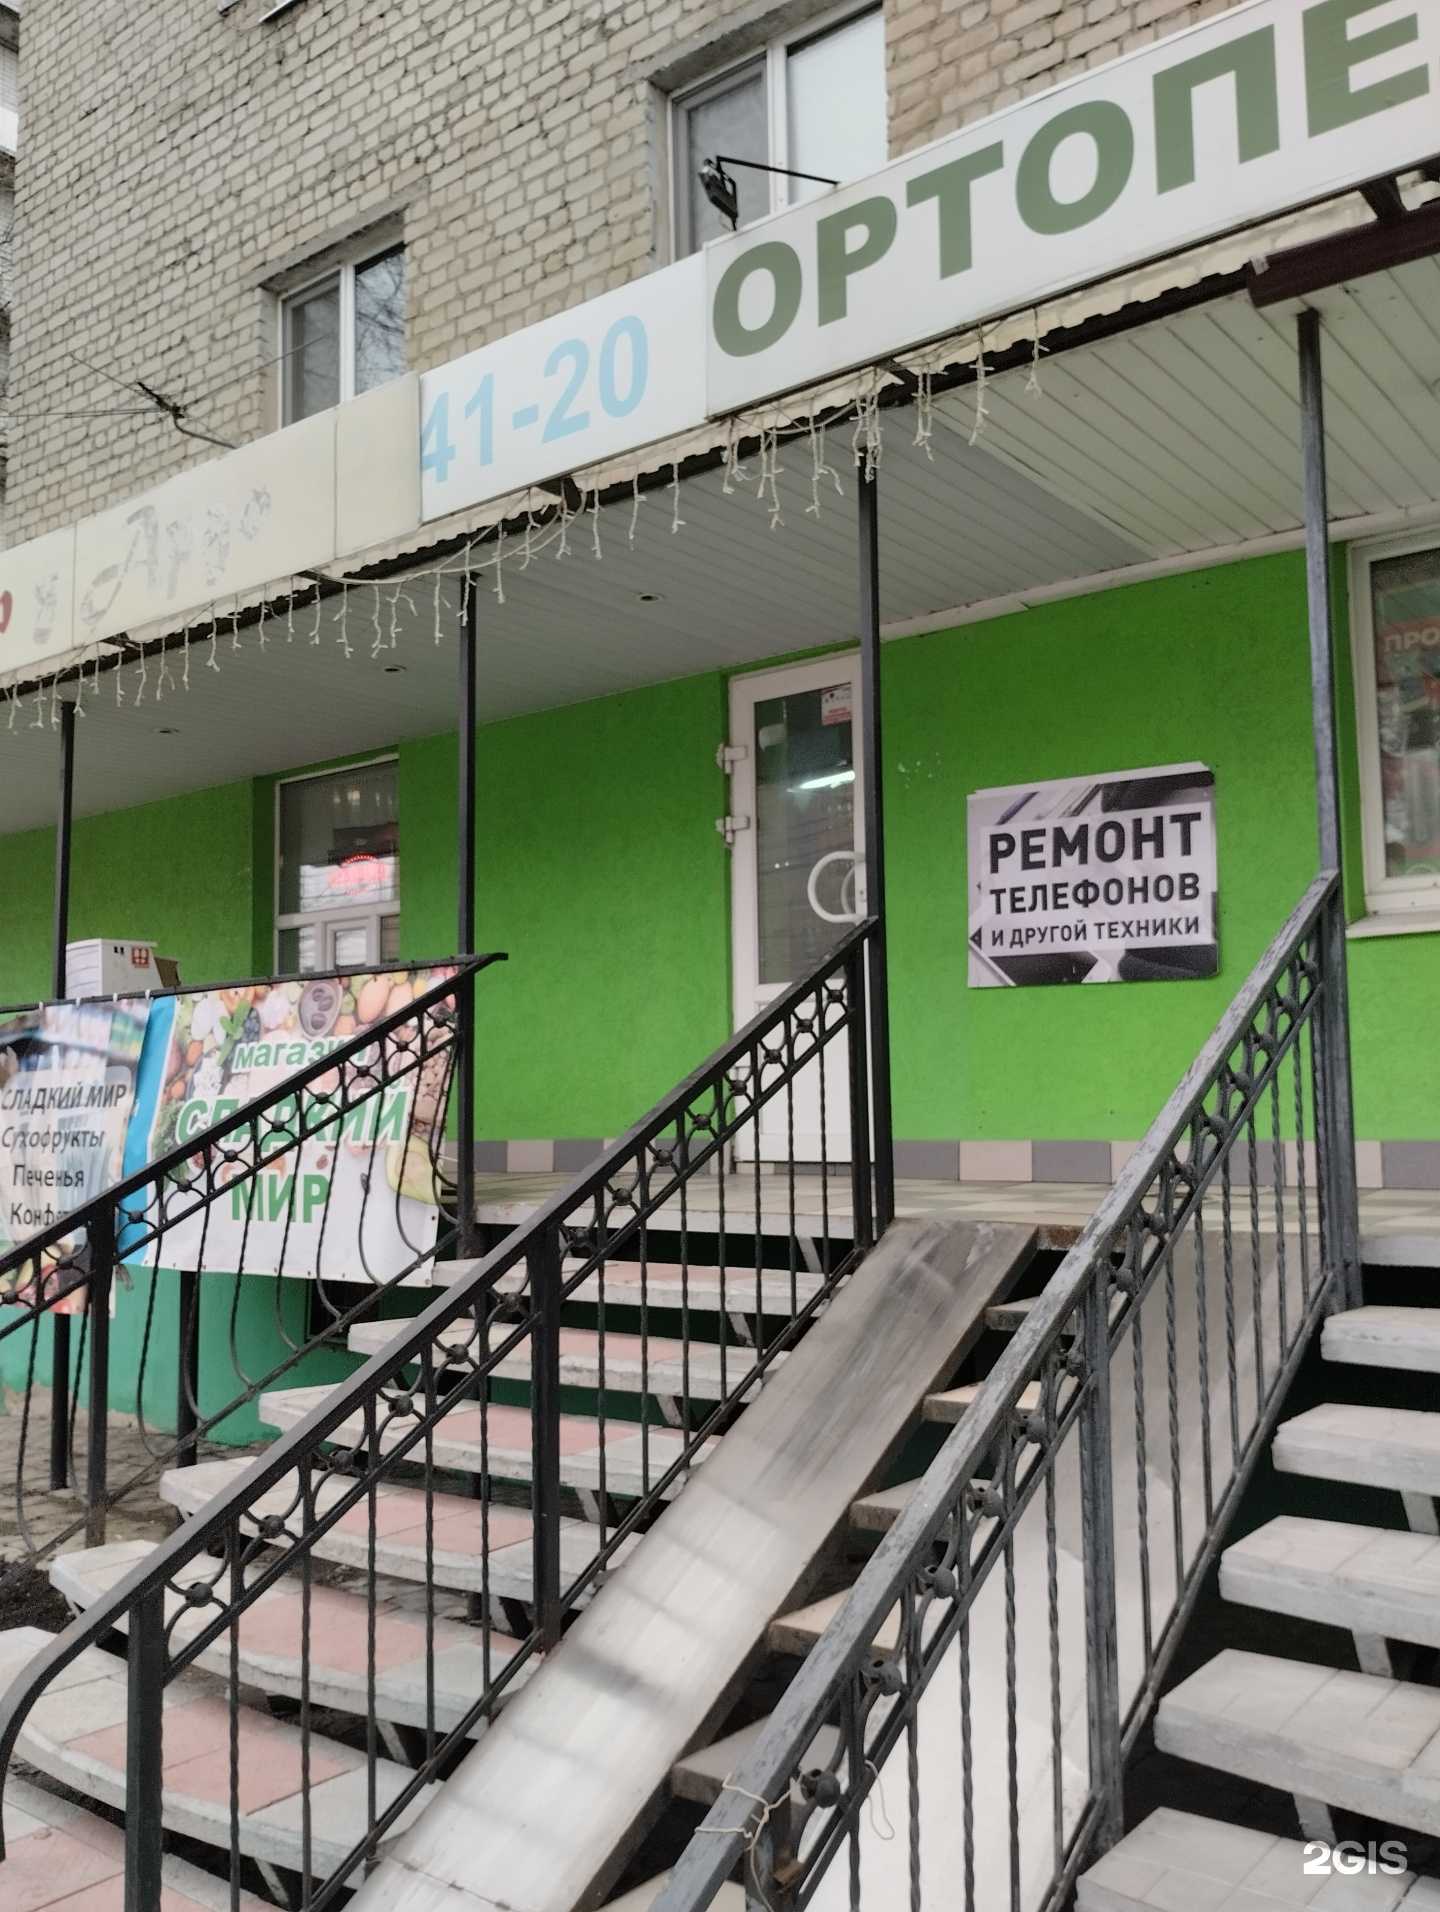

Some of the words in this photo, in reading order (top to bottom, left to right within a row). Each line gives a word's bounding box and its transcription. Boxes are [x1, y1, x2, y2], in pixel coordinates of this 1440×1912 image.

[712, 0, 1431, 358] ОРТОПЕ
[421, 315, 649, 483] 41-20
[989, 812, 1201, 874] РЕМОНТ
[989, 872, 1200, 915] ТЕЛЕФОНОВ
[991, 930, 1004, 947] И
[1009, 919, 1088, 948] ДРУГОЙ
[1094, 916, 1200, 940] ТЕХНИКИ
[235, 1039, 367, 1068] магаз
[1, 1082, 84, 1115] СЛАДКИЙ
[85, 1084, 128, 1108] МИР
[2, 1125, 105, 1153] Сухофрукты
[13, 1164, 85, 1187] Печенья
[231, 1173, 330, 1224] МИР
